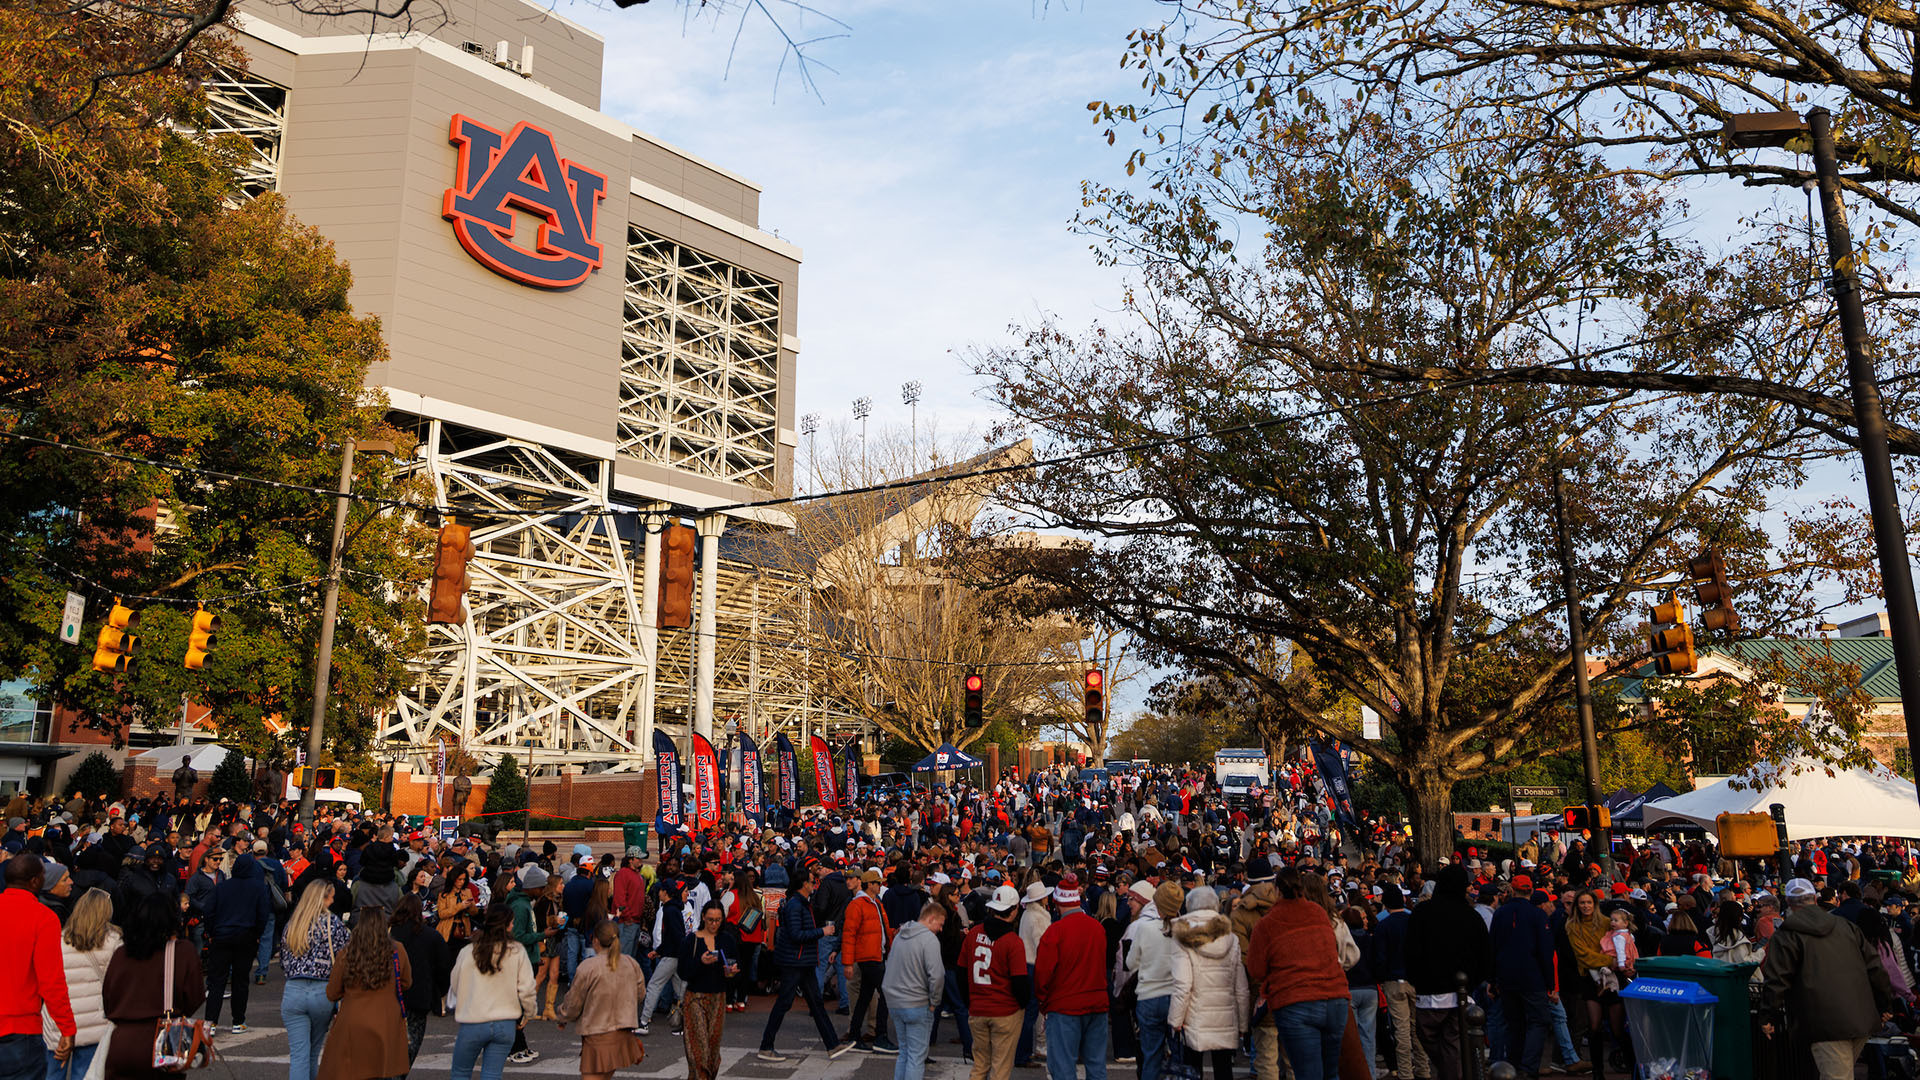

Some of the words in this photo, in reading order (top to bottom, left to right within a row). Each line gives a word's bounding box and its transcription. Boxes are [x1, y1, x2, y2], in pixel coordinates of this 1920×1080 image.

[659, 751, 674, 825] AUBURN
[697, 755, 711, 821] AUBURN
[744, 751, 755, 813] AUBURN
[780, 751, 791, 809] AUBURN
[816, 752, 832, 802] AUBURN
[1524, 788, 1554, 796] Donahue
[973, 945, 992, 985] 2
